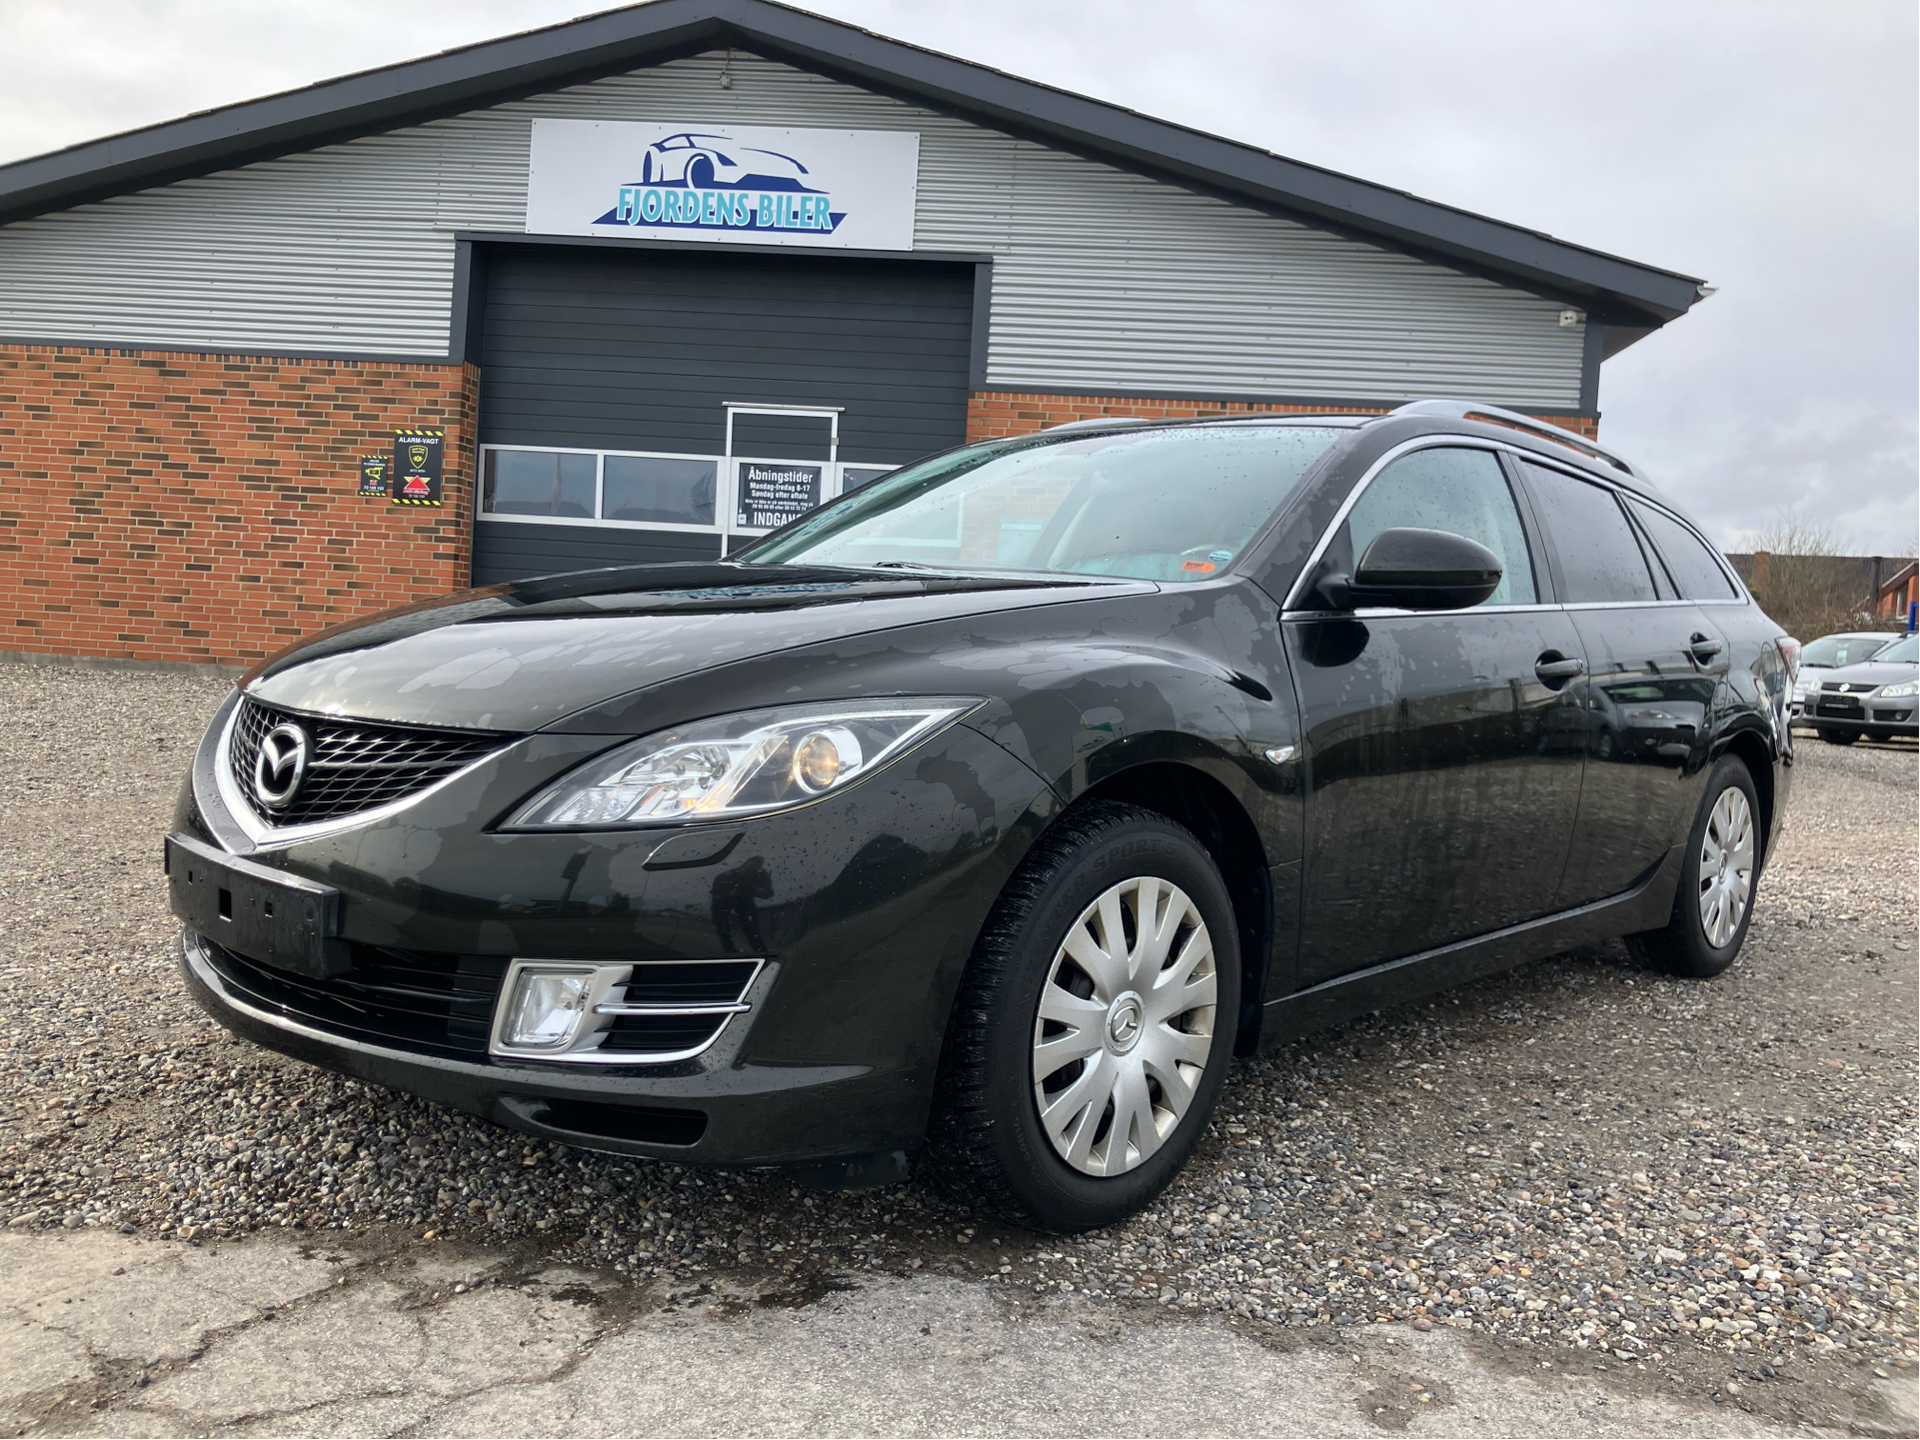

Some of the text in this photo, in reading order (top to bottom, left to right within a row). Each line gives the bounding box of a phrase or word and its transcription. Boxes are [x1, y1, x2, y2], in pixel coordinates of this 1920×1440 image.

[616, 188, 833, 229] FJORDENS BILER
[398, 436, 439, 444] ALARM-VAGT
[748, 466, 813, 483] Åbningstider
[751, 489, 774, 499] Søndag
[790, 492, 808, 500] aftale
[1093, 839, 1161, 874] SPORT
